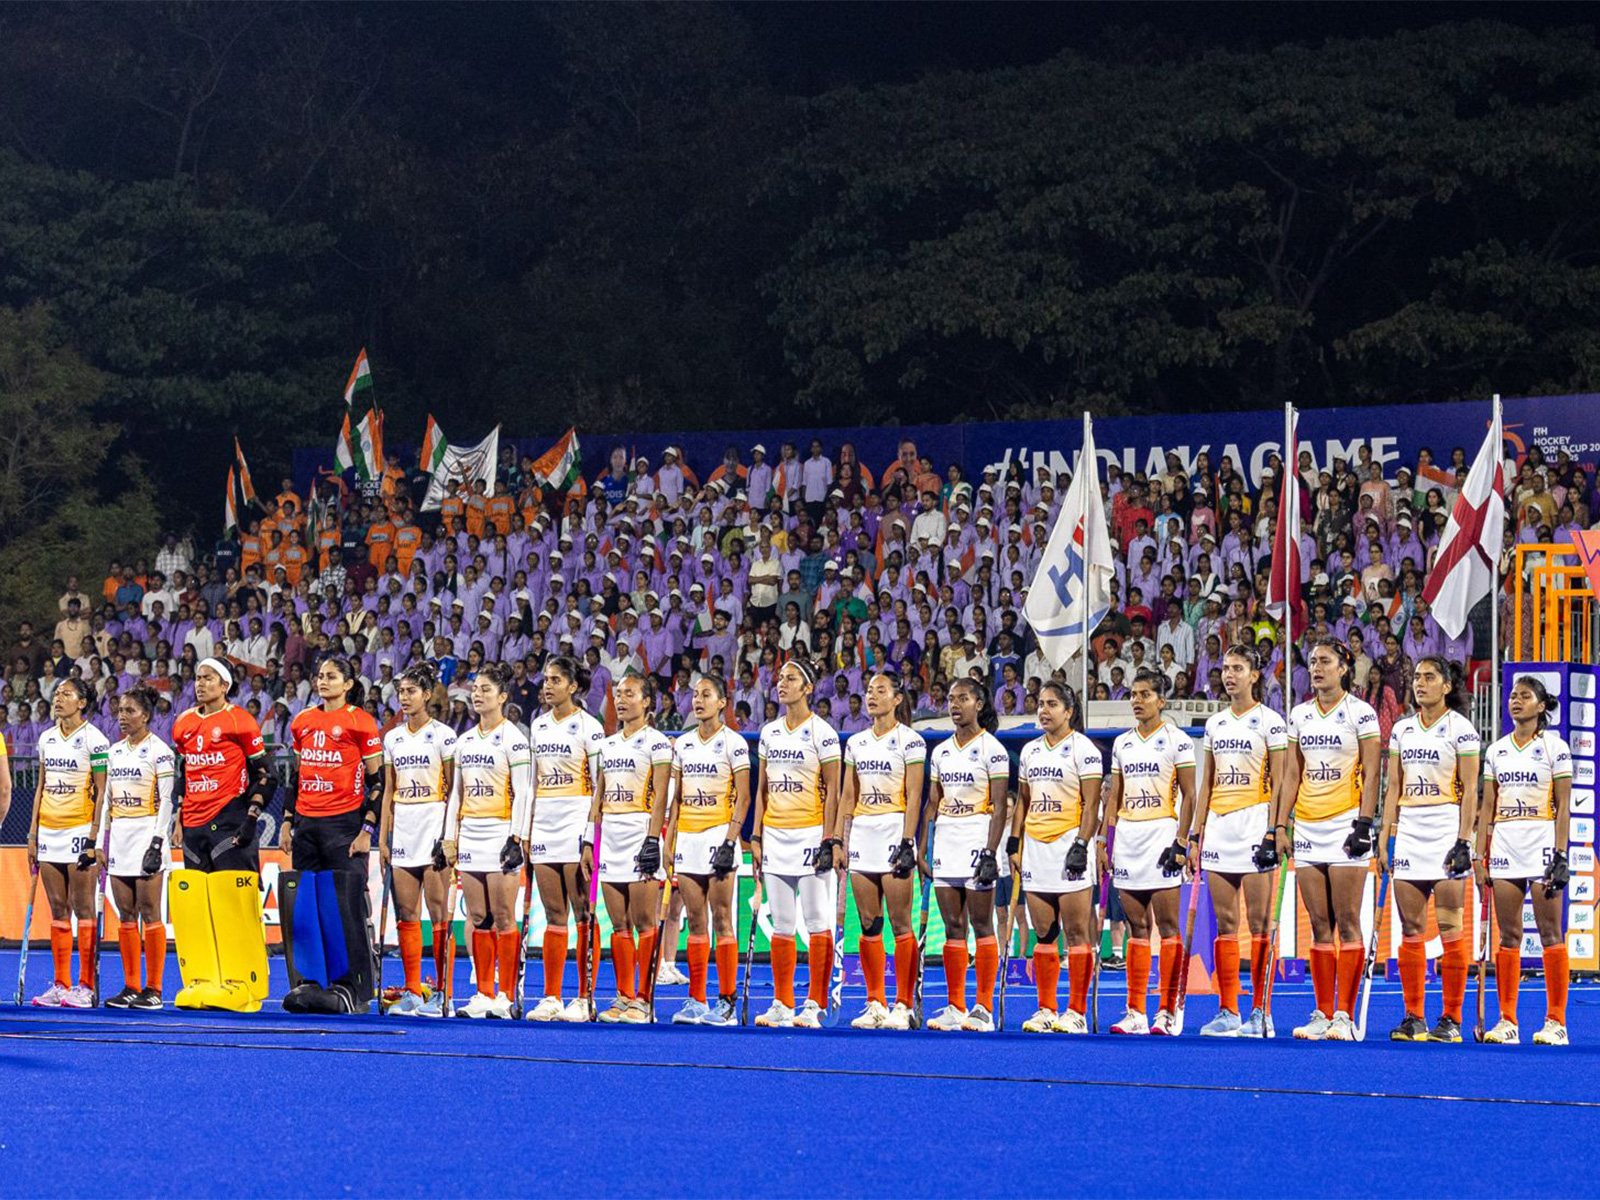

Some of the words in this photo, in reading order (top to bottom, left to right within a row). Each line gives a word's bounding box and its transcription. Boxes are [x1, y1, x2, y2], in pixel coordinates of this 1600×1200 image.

[1534, 436, 1570, 446] HOCKEY
[1569, 443, 1588, 452] CUP
[196, 735, 204, 752] 9
[313, 730, 325, 748] 10
[1214, 739, 1252, 750] ODISHA
[1300, 735, 1342, 746] ODISHA
[535, 743, 572, 754] ODISHA
[1402, 748, 1440, 760] ODISHA
[186, 752, 226, 766] ODISHA
[301, 748, 343, 761] ODISHA
[462, 754, 495, 765] ODISHA
[394, 755, 430, 767] ODISHA
[603, 758, 636, 769] ODISHA
[856, 760, 892, 771] ODISHA
[683, 763, 718, 774] ODISHA
[1028, 767, 1064, 778] ODISHA
[1124, 762, 1160, 774] ODISHA
[940, 772, 974, 783] ODISHA
[1498, 771, 1538, 783] ODISHA
[235, 877, 252, 887] BK
